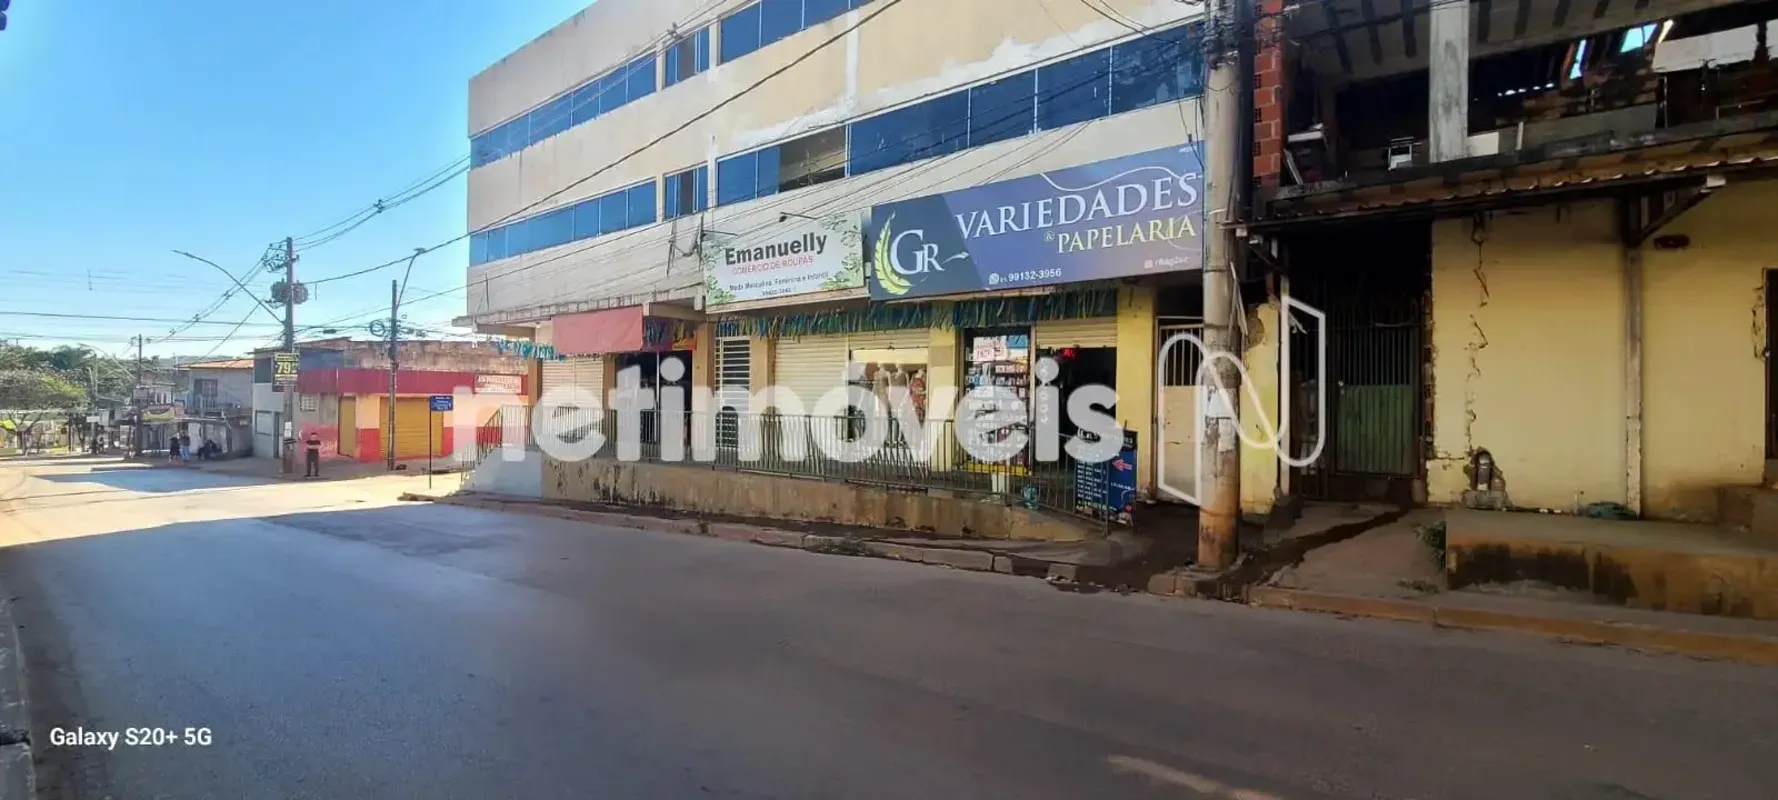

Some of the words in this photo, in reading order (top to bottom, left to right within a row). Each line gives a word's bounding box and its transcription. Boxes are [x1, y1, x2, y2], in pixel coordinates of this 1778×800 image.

[954, 172, 1199, 240] VARIEDADES
[724, 231, 827, 265] Emanuelly
[1043, 230, 1056, 243] &
[1057, 216, 1197, 254] PAPELARIA
[782, 256, 814, 267] ROUPAS
[1008, 268, 1062, 281] 99132-3956
